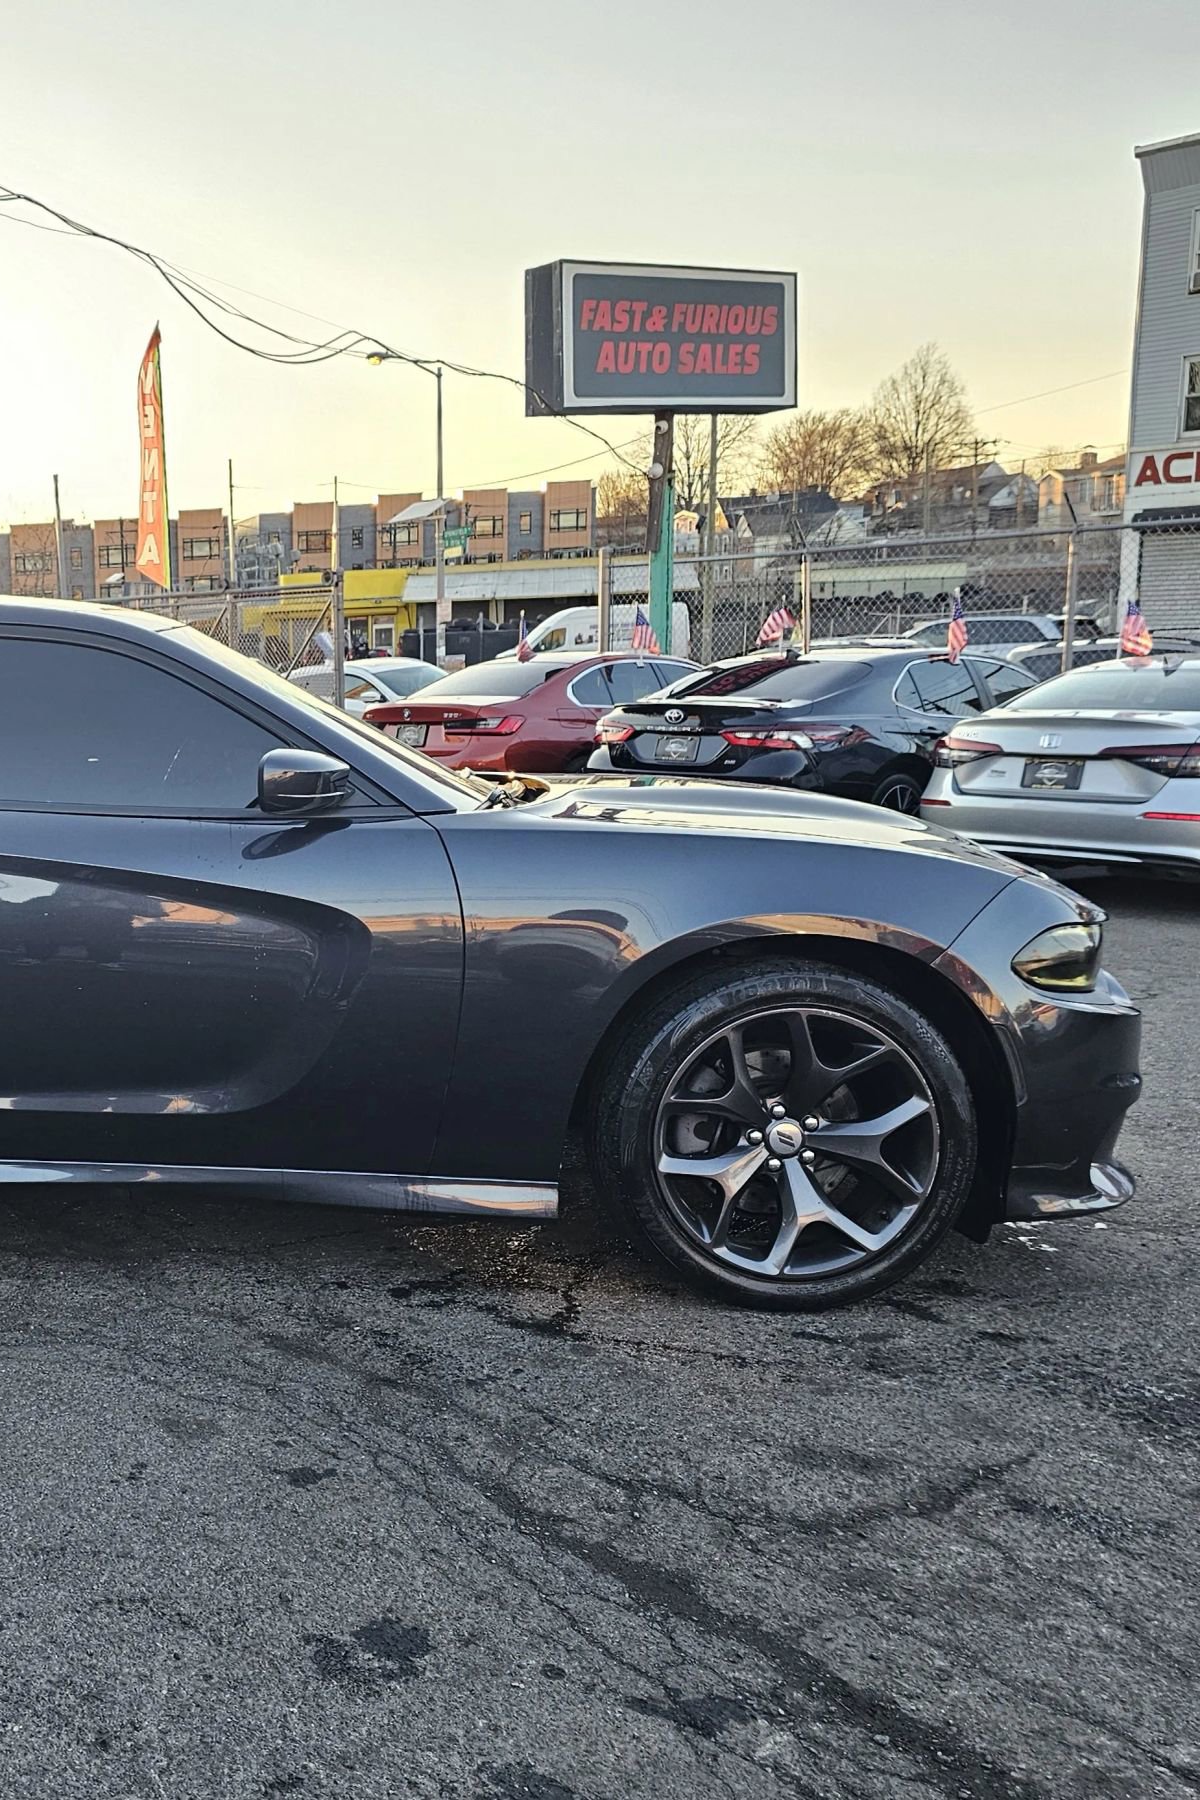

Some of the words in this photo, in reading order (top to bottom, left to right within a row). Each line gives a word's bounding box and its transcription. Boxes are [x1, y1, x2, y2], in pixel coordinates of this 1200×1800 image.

[671, 303, 778, 336] FURIOUS
[596, 340, 671, 374] AUTO
[677, 342, 761, 375] SALES
[1134, 451, 1200, 487] AC
